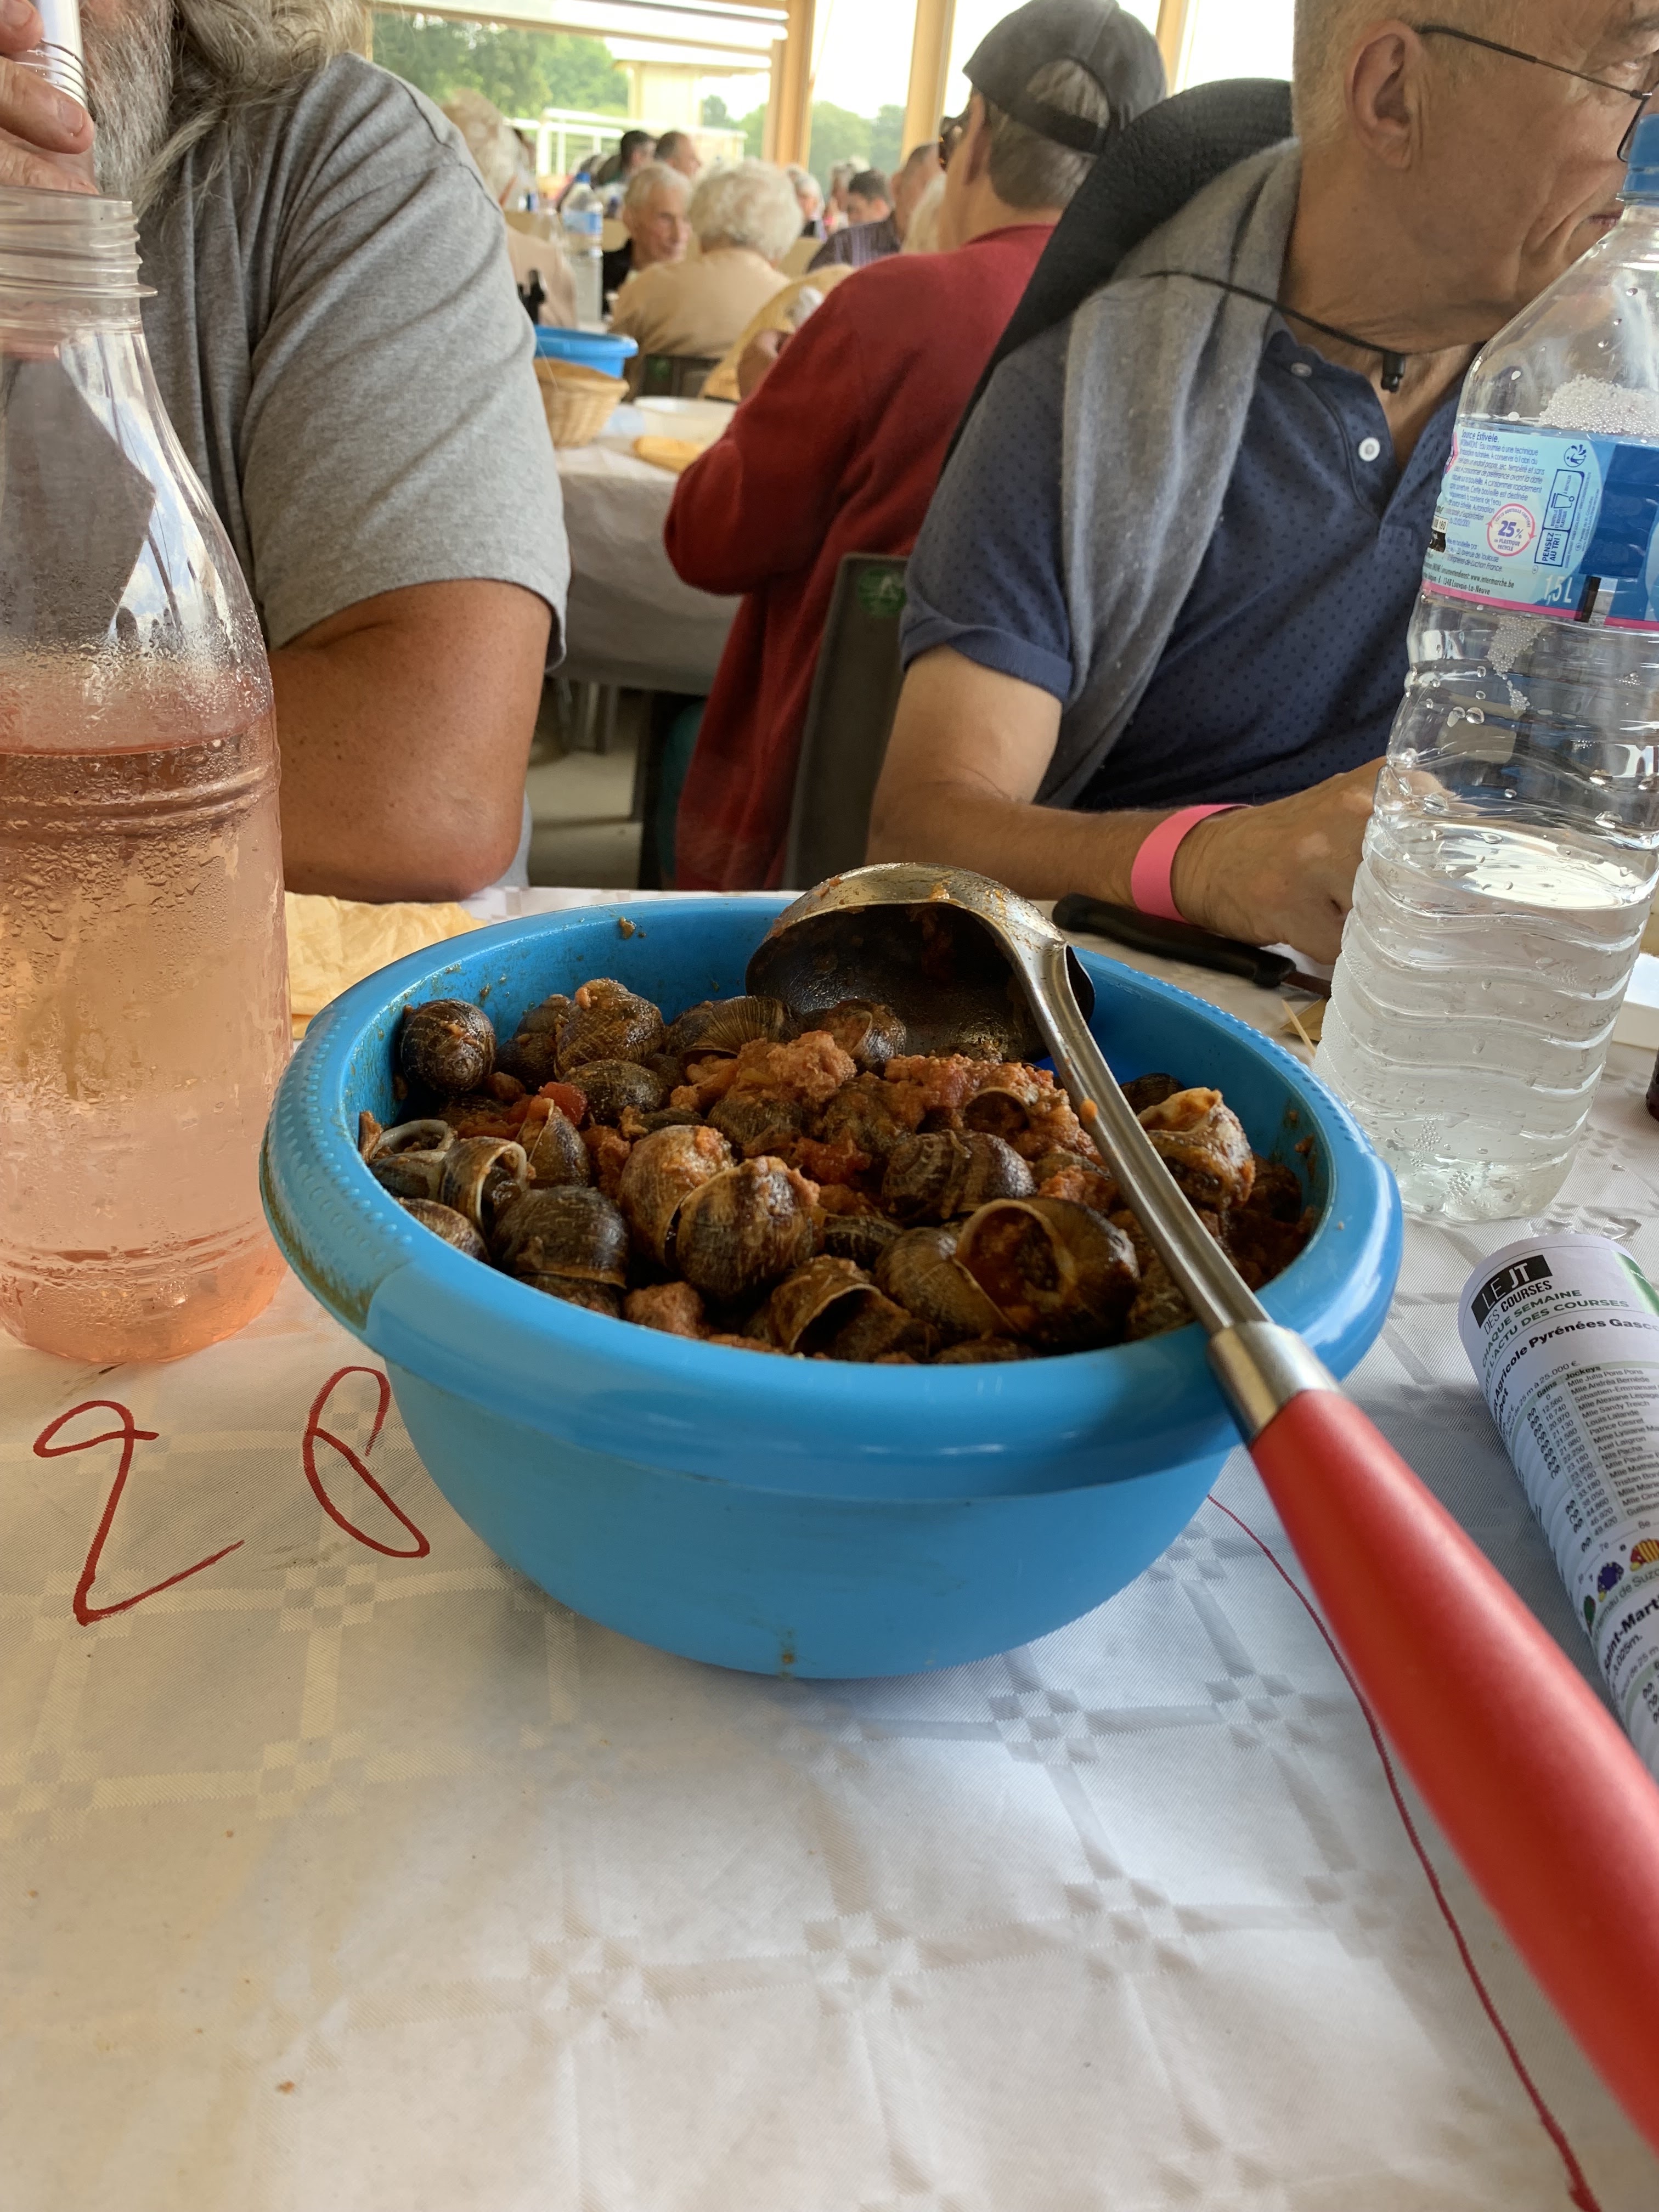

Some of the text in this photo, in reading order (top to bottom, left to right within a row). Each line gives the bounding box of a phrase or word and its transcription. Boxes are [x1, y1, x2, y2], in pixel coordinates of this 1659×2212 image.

[1462, 429, 1476, 439] Source
[1514, 445, 1539, 456] technique
[1494, 454, 1514, 463] conserver
[1510, 473, 1525, 482] avant
[1513, 483, 1543, 493] rapidement
[1506, 491, 1528, 501] destinée
[1499, 538, 1521, 547] PLASTIQUE
[1542, 532, 1554, 562] PENSEZ
[1481, 553, 1499, 563] Toulouse
[1550, 551, 1557, 561] AU
[1452, 579, 1491, 595] Louvain-La-Neuve
[1543, 575, 1573, 606] 1,5 L
[1482, 1262, 1530, 1310] LE JT
[1483, 1280, 1553, 1335] DES COURSES
[1482, 1290, 1582, 1368] CHAQUE SEMAINE
[1489, 1300, 1629, 1368] L'ACTU DES COURSES
[1495, 1347, 1528, 1400] Agricole
[1528, 1321, 1606, 1348] Pyrénées
[1537, 1366, 1601, 1398] Gains Jockeys
[1585, 1373, 1603, 1381] Julia
[1519, 1395, 1527, 1406] 25
[1526, 1387, 1534, 1396] m
[1539, 1363, 1570, 1384] 25.000
[1596, 1394, 1629, 1405] Alexiane
[1599, 1403, 1624, 1413] Sandy
[1585, 1417, 1607, 1427] Louis
[1589, 1424, 1616, 1435] Patrice
[1598, 1442, 1615, 1453] Axel
[1601, 1446, 1643, 1461] Nils Pacha
[1614, 1476, 1642, 1487] Tristan
[1620, 1584, 1632, 1598] de
